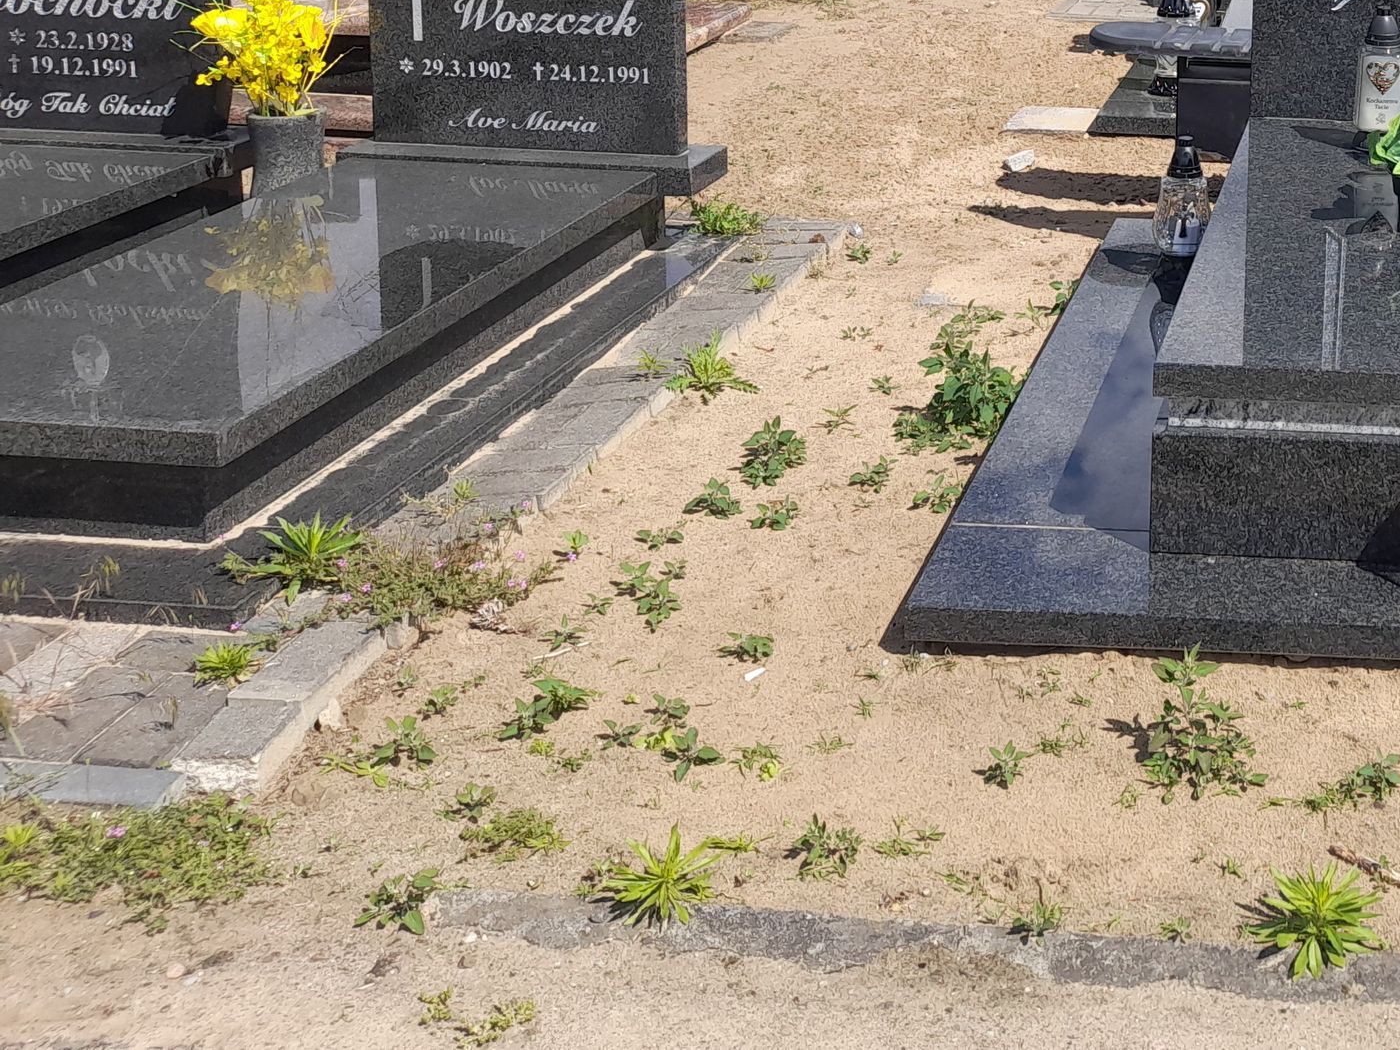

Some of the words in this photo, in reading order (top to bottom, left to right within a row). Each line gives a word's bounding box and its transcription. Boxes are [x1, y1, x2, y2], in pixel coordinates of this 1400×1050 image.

[35, 30, 135, 51] 23.2.1928
[30, 55, 138, 78] 19.12.1991
[422, 59, 512, 79] 29.3.1902
[549, 64, 651, 85] 24.12.1991
[0, 92, 32, 118] óg
[41, 92, 91, 115] Tak
[99, 94, 176, 117] Chciał
[448, 108, 505, 130] Ave
[512, 110, 600, 133] Maria
